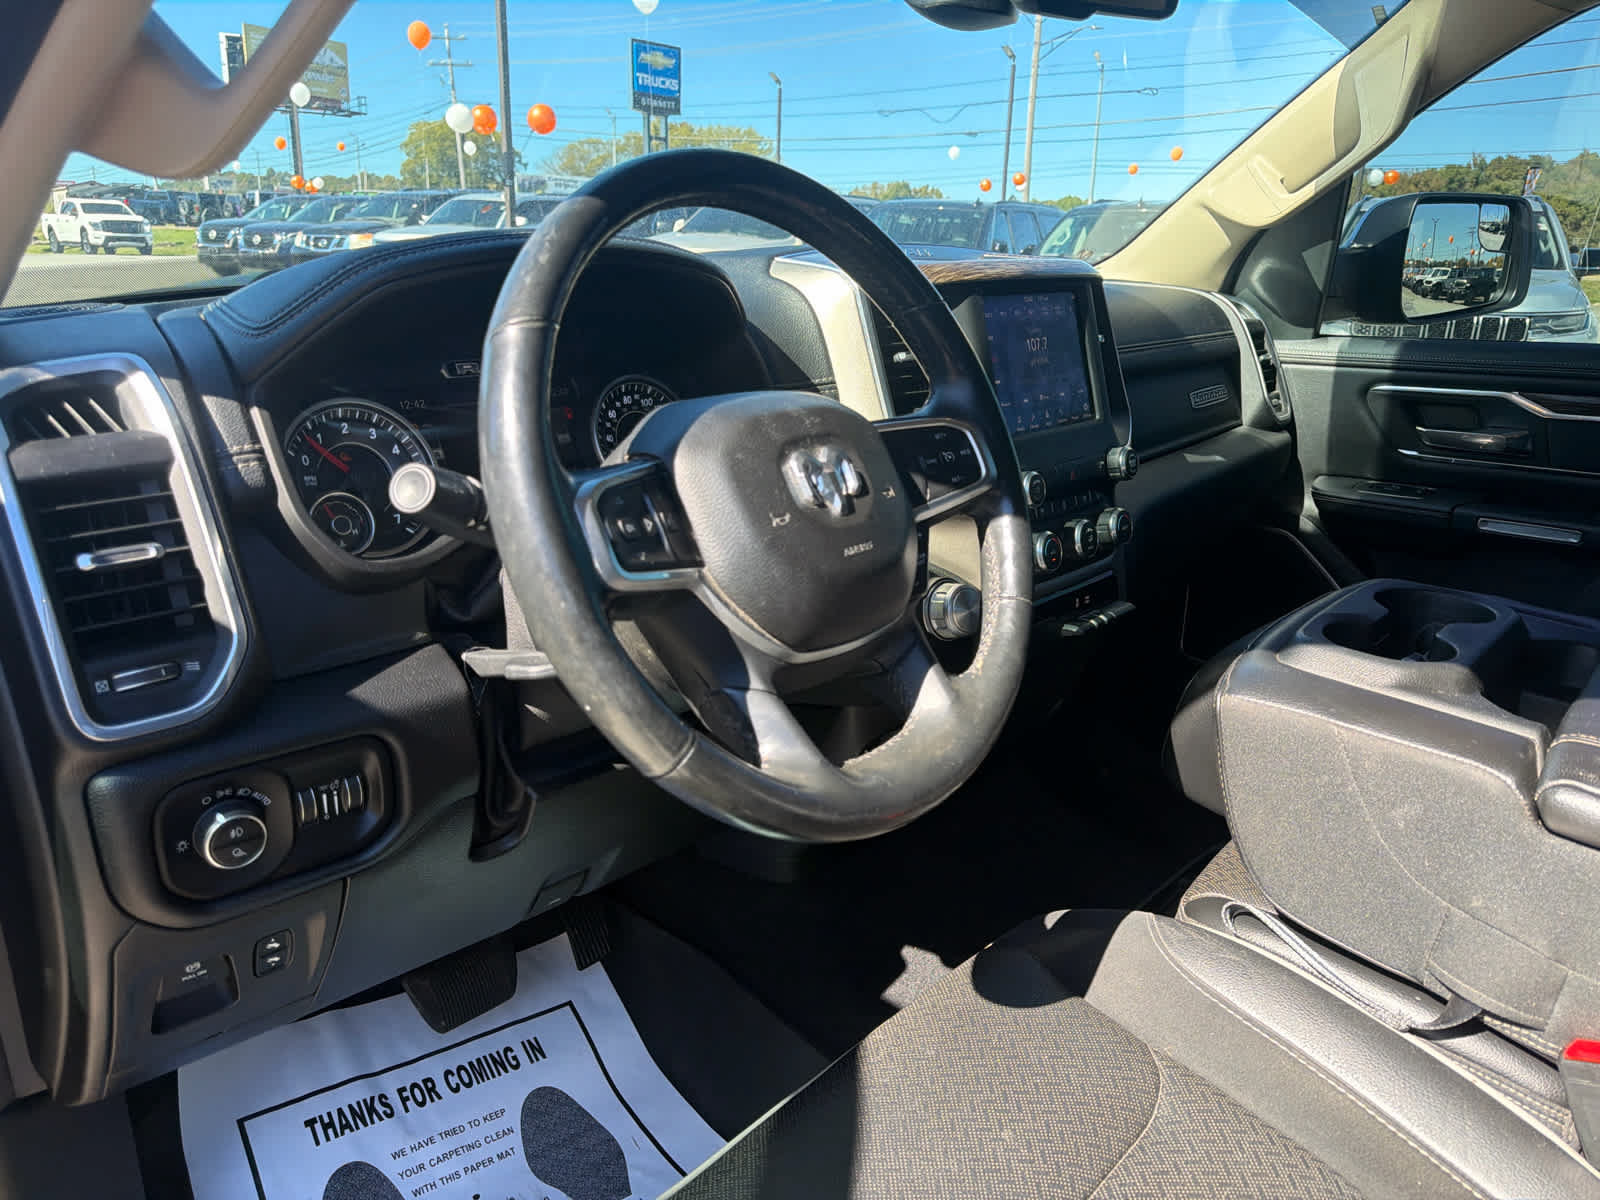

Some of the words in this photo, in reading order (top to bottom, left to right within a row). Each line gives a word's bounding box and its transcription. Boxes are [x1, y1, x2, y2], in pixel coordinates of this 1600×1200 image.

[636, 72, 679, 91] TRUCKS
[340, 422, 350, 435] 2
[368, 428, 377, 440] 3
[316, 433, 323, 445] 1
[391, 444, 401, 456] 4
[301, 455, 310, 467] 0
[393, 513, 401, 525] 7
[252, 791, 272, 806] AUTO
[303, 1093, 395, 1147] THANKS
[396, 1076, 443, 1114] FOR
[443, 1046, 521, 1094] COMING
[520, 1036, 547, 1064] IN
[390, 1147, 408, 1161] WE
[409, 1135, 437, 1154] HAVE
[438, 1124, 466, 1141] TRIED
[467, 1118, 481, 1129] TO
[482, 1107, 506, 1124] KEEP
[397, 1162, 427, 1180] YOUR
[428, 1139, 483, 1168] CARPETING
[483, 1126, 515, 1145] CLEAN
[411, 1181, 438, 1198] WITH
[438, 1170, 462, 1187] THIS
[463, 1156, 496, 1176] PAPER
[496, 1146, 517, 1161] MAT
